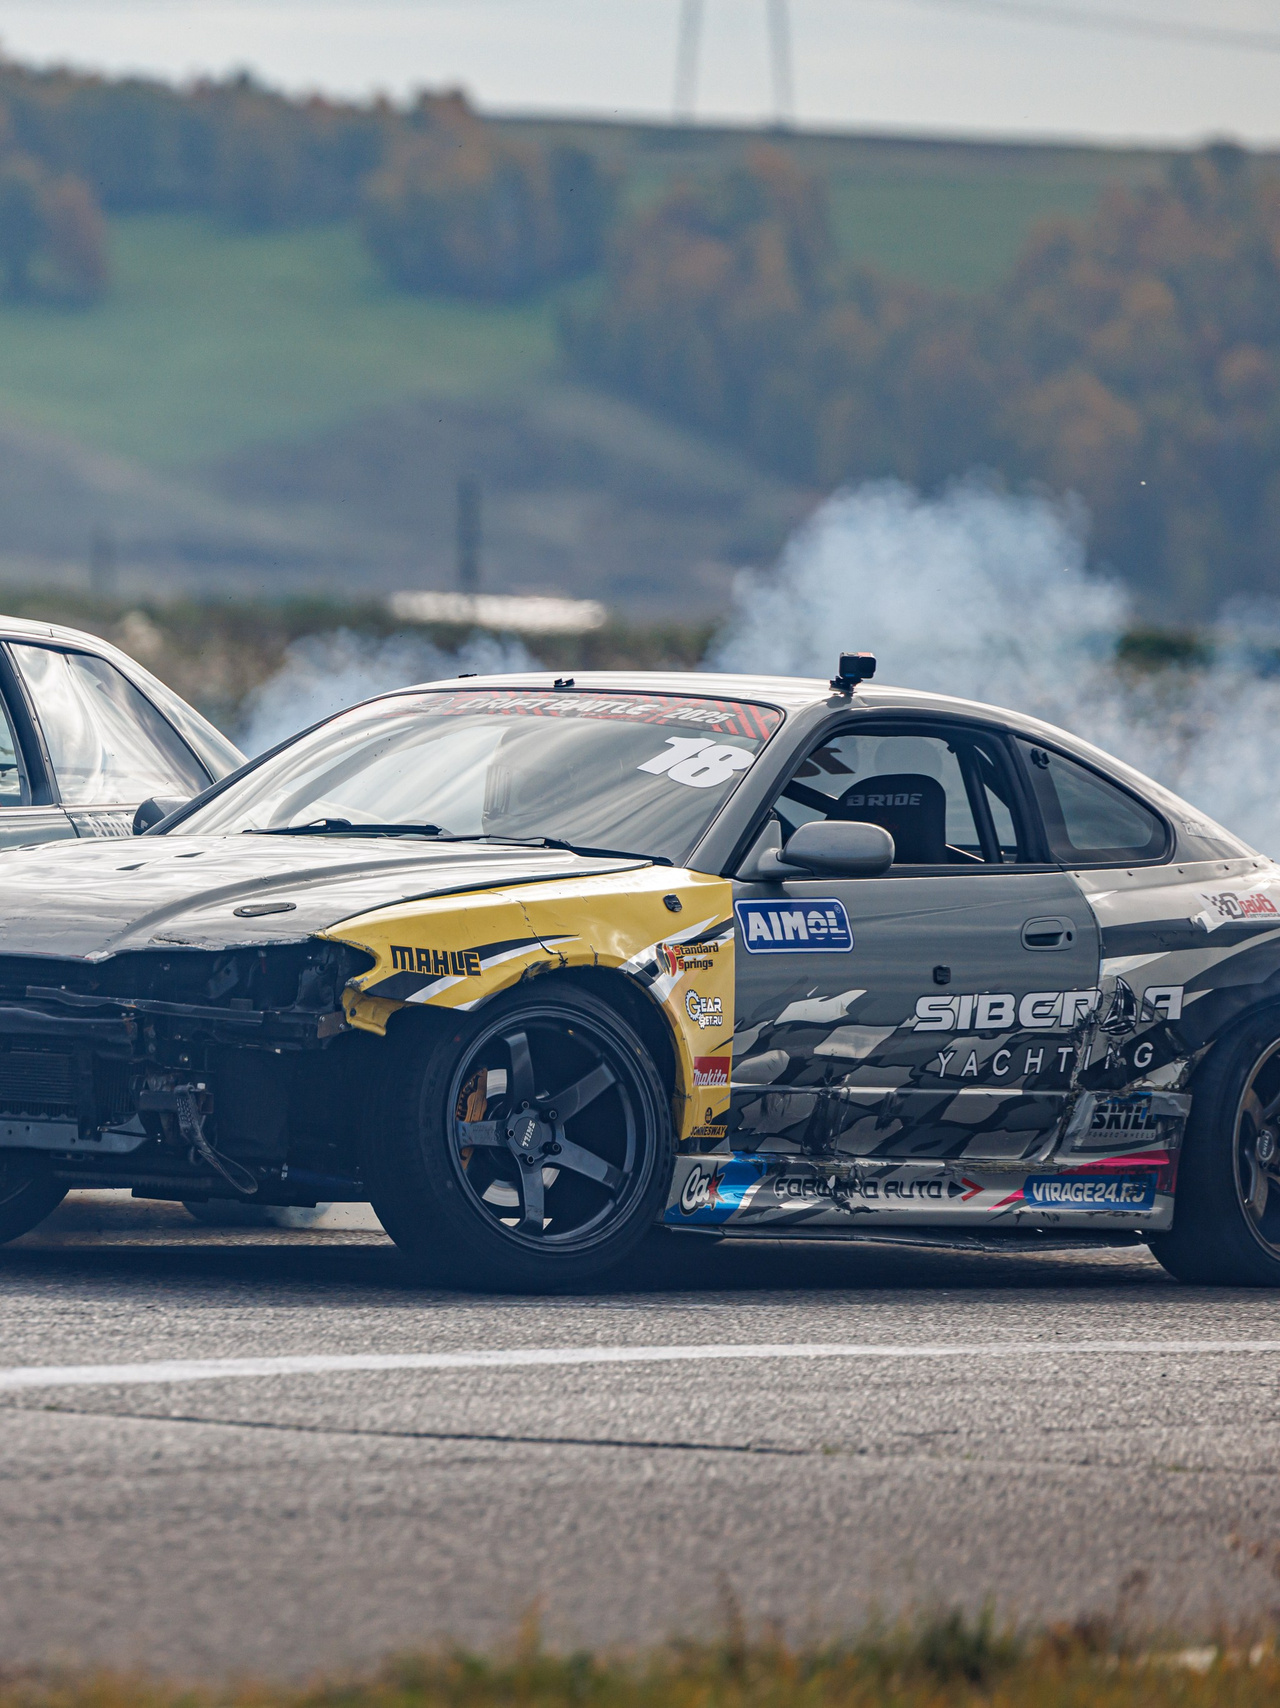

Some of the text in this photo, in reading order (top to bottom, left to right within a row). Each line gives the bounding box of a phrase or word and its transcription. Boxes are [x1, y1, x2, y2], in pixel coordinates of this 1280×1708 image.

[455, 697, 544, 712] DRIFT
[541, 699, 660, 716] BATTLE
[665, 707, 739, 725] 2025
[636, 737, 756, 788] 18
[846, 793, 923, 807] BRIDE
[747, 910, 848, 941] AIMOL
[390, 944, 482, 977] MAHLE
[673, 942, 719, 956] Standard
[678, 957, 714, 972] Springs
[913, 982, 1185, 1034] SIBERA
[1091, 1104, 1157, 1130] SKILL
[884, 1180, 943, 1199] AUTO
